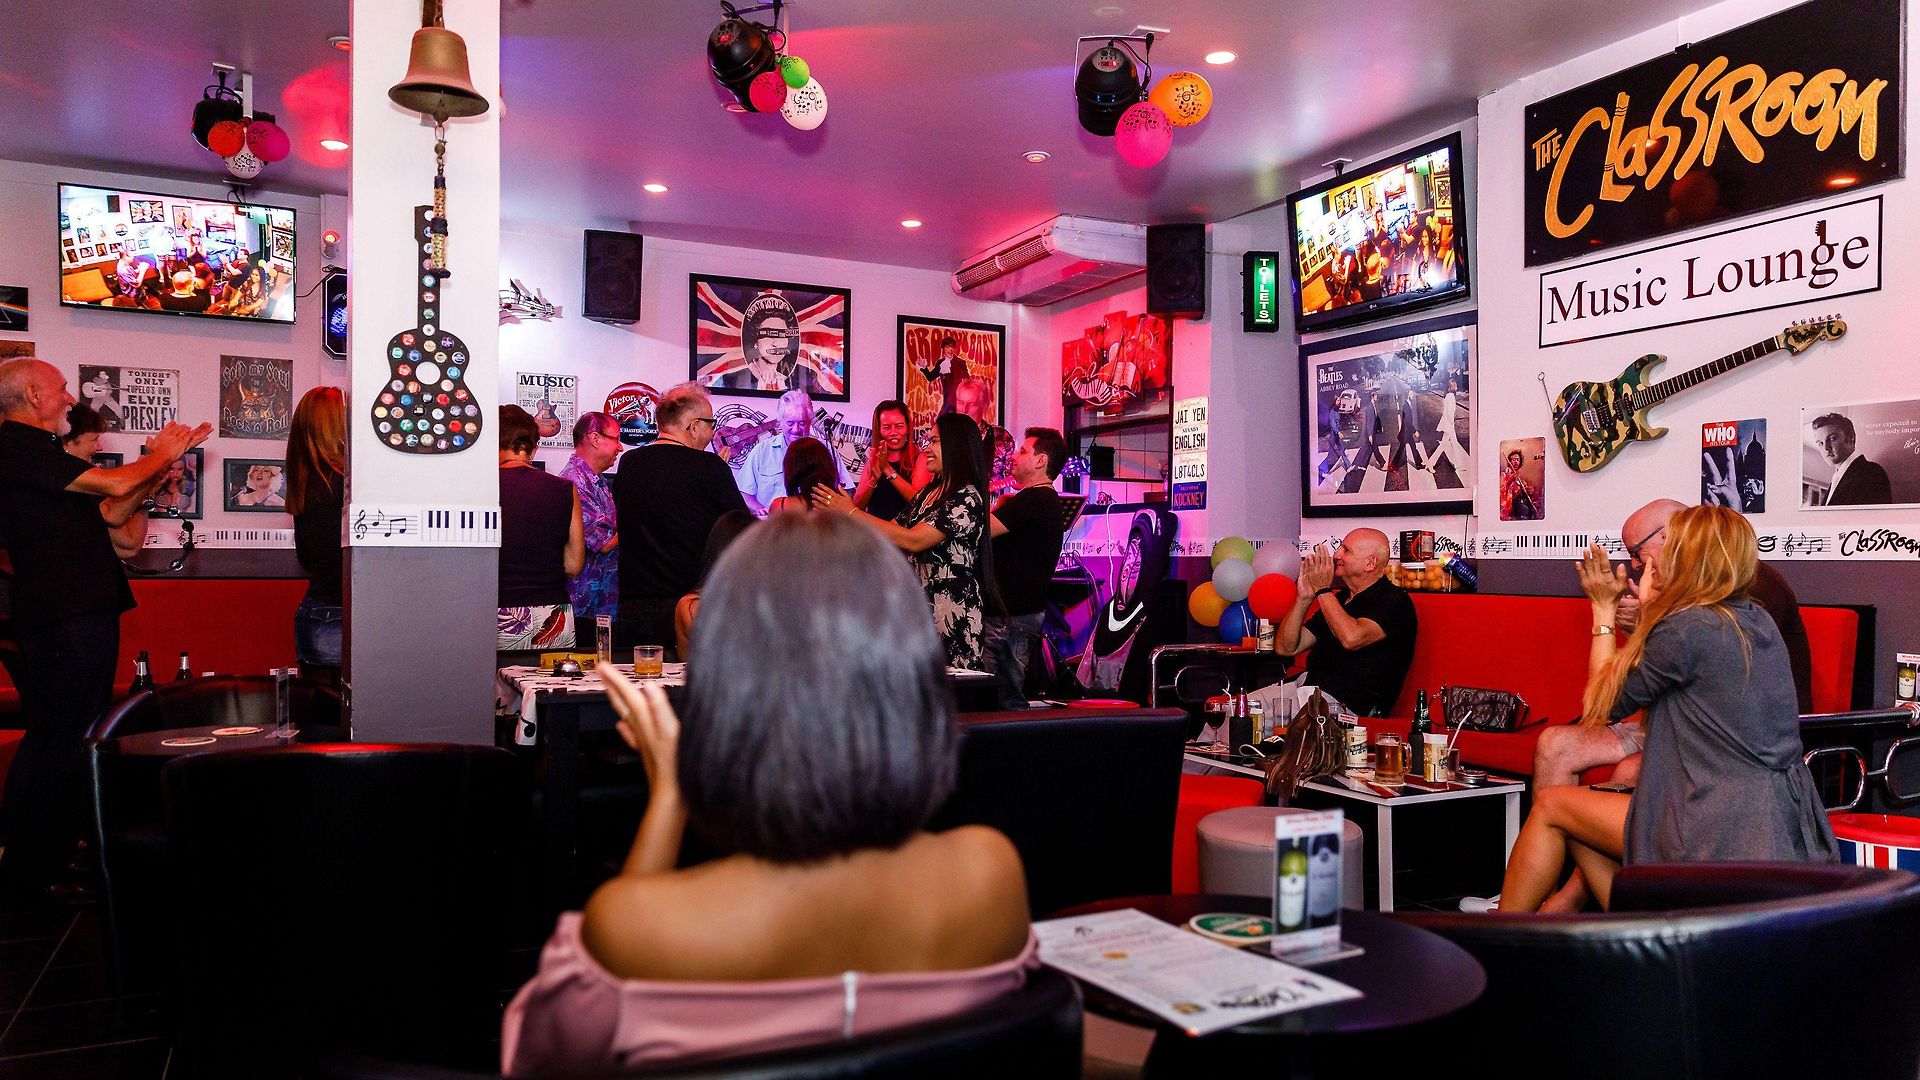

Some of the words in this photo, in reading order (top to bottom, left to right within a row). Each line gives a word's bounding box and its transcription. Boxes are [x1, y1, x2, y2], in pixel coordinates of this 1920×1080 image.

[1532, 128, 1562, 171] THE
[1547, 267, 1666, 325] Music
[1683, 220, 1869, 301] Lounge
[1258, 258, 1270, 318] TOILETS
[127, 370, 171, 379] TONIGHT
[135, 377, 165, 386] ONLY
[519, 374, 574, 388] MUSIC
[1319, 368, 1343, 384] BEATLES
[127, 394, 171, 406] ELVIS
[608, 394, 636, 412] Victor
[1175, 409, 1188, 425] JAI
[1192, 406, 1206, 421] YEN
[1174, 433, 1206, 450] ENGLISH
[1704, 425, 1736, 442] WHO
[1173, 491, 1205, 506] KOCKNEY
